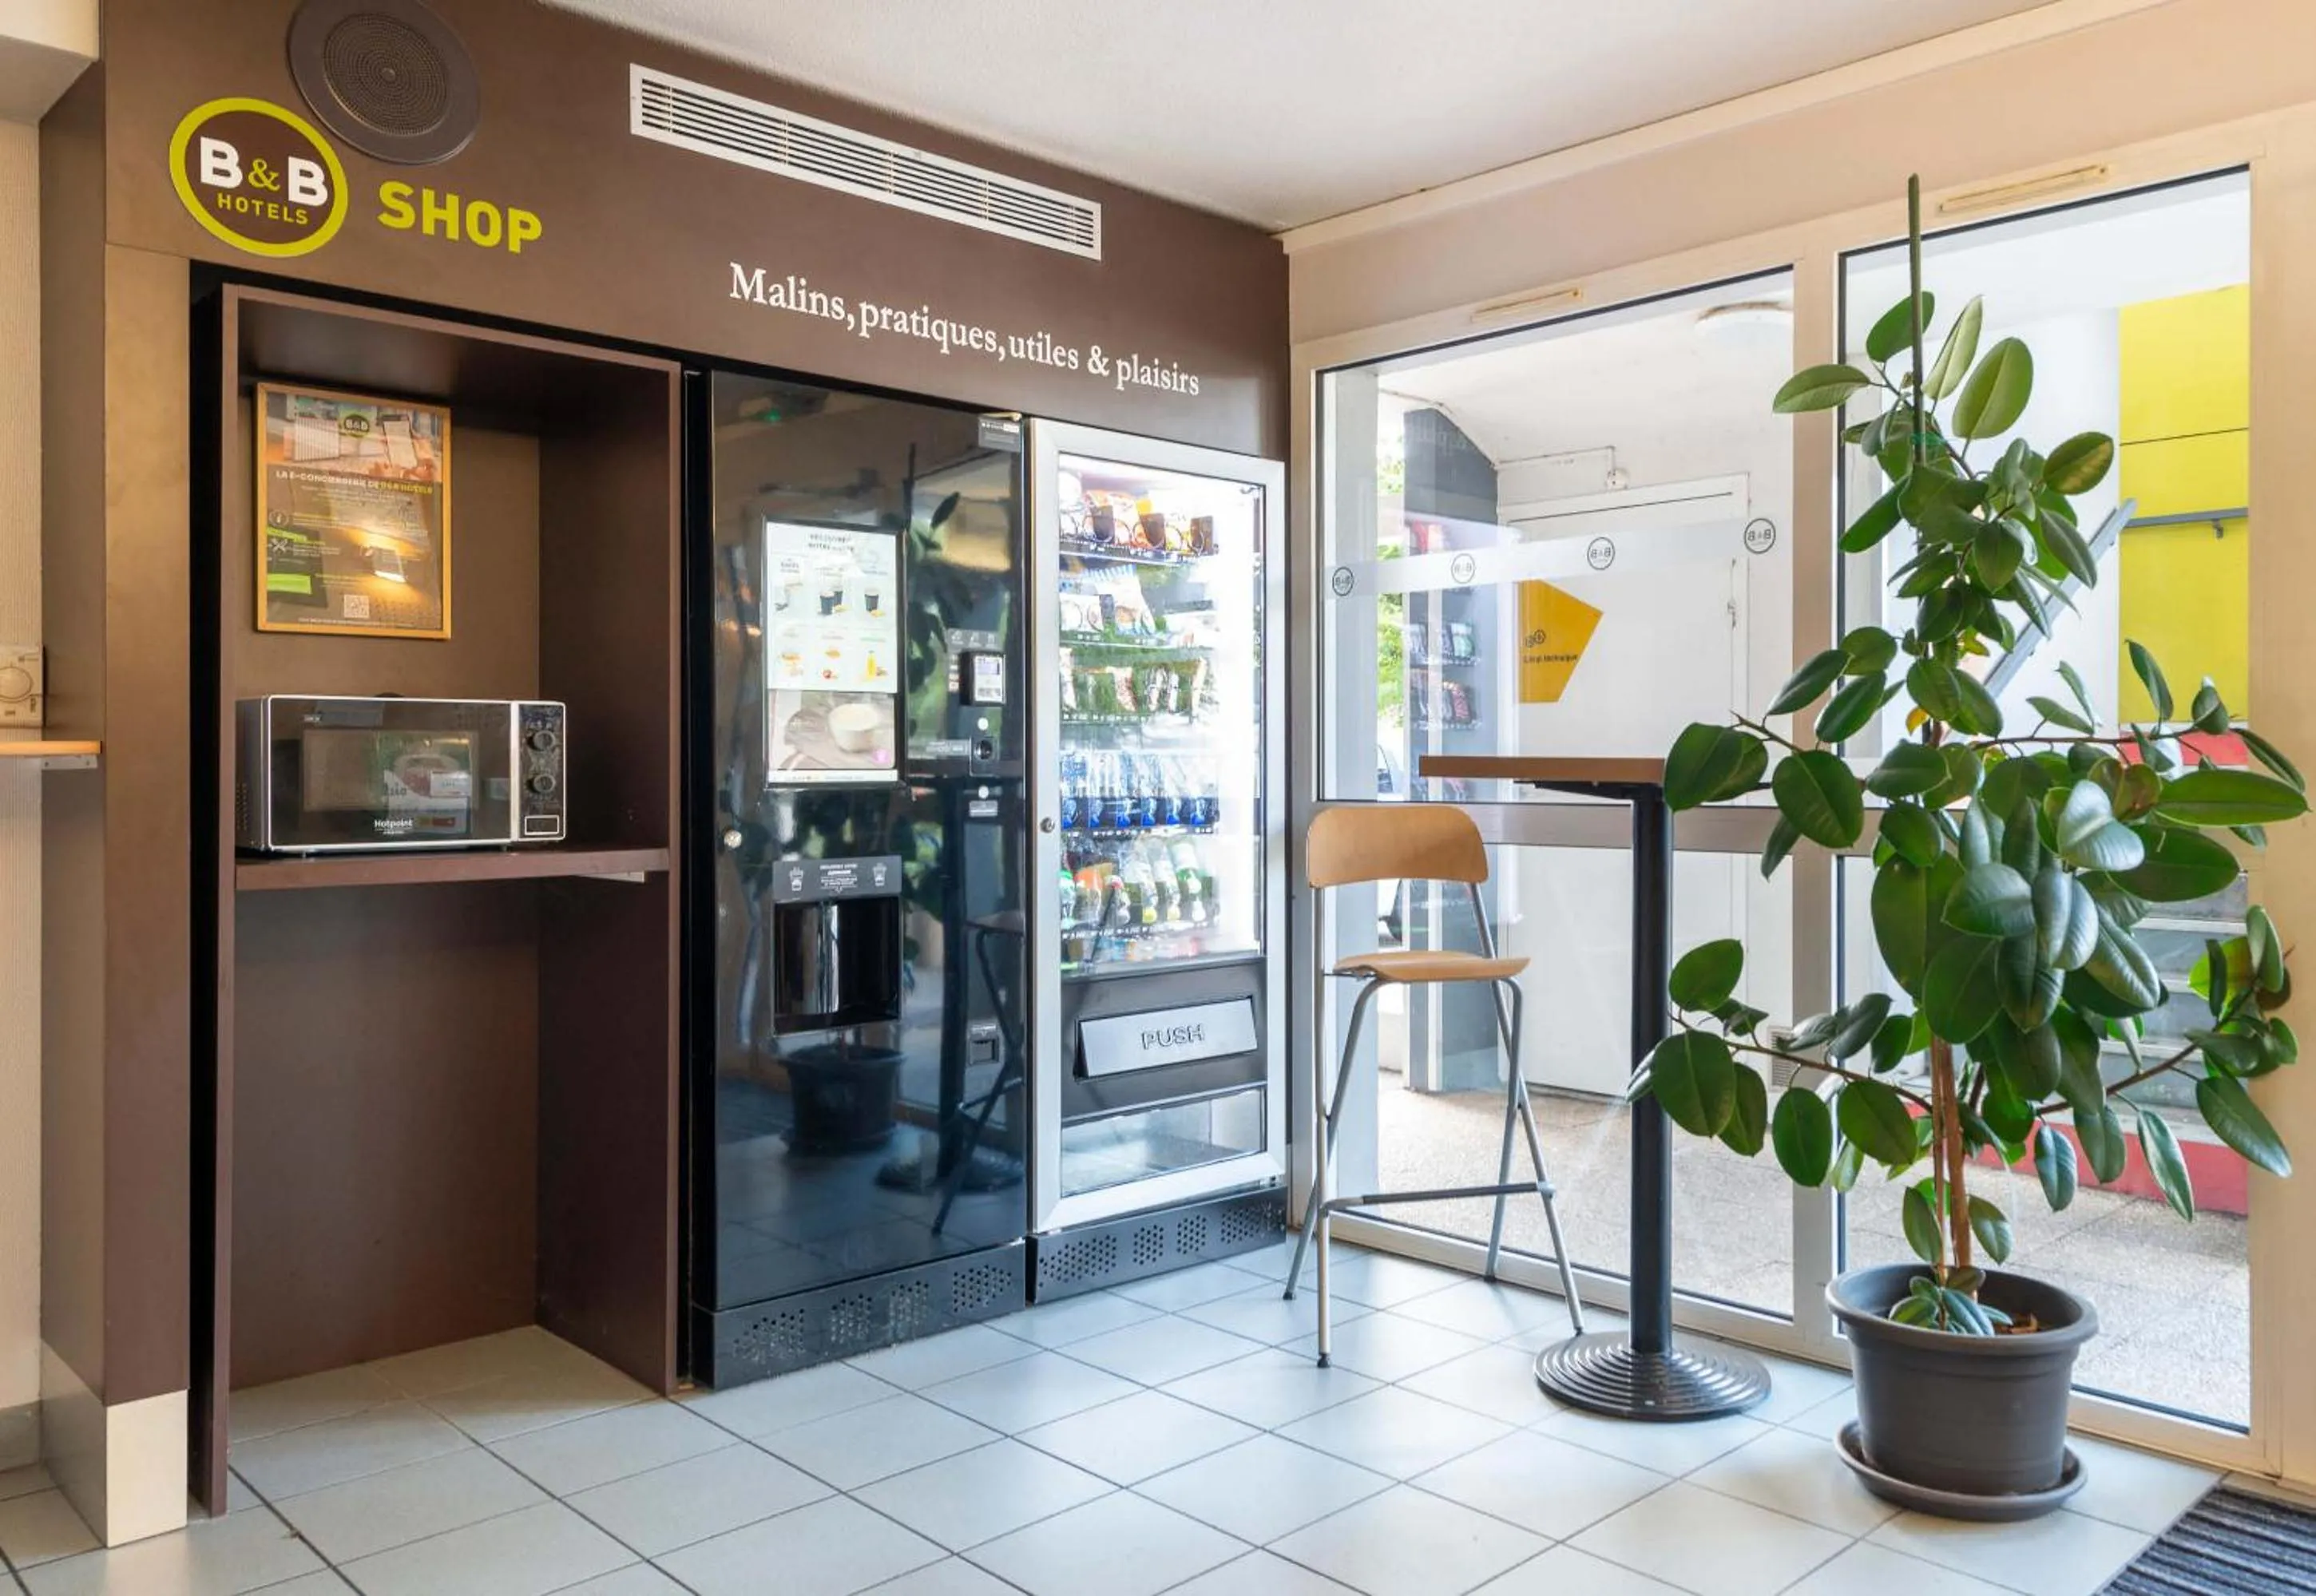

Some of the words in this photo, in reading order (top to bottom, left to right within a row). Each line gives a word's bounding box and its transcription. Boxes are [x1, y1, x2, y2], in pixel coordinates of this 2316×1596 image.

[200, 137, 328, 208] B&B
[216, 193, 309, 225] HOTELS
[377, 180, 543, 253] SHOP
[1008, 331, 1079, 370] utiles
[1087, 345, 1109, 376] &
[1116, 354, 1199, 395] plaisirs
[374, 818, 413, 829] Hotpoint
[1141, 1024, 1204, 1049] PUSH
